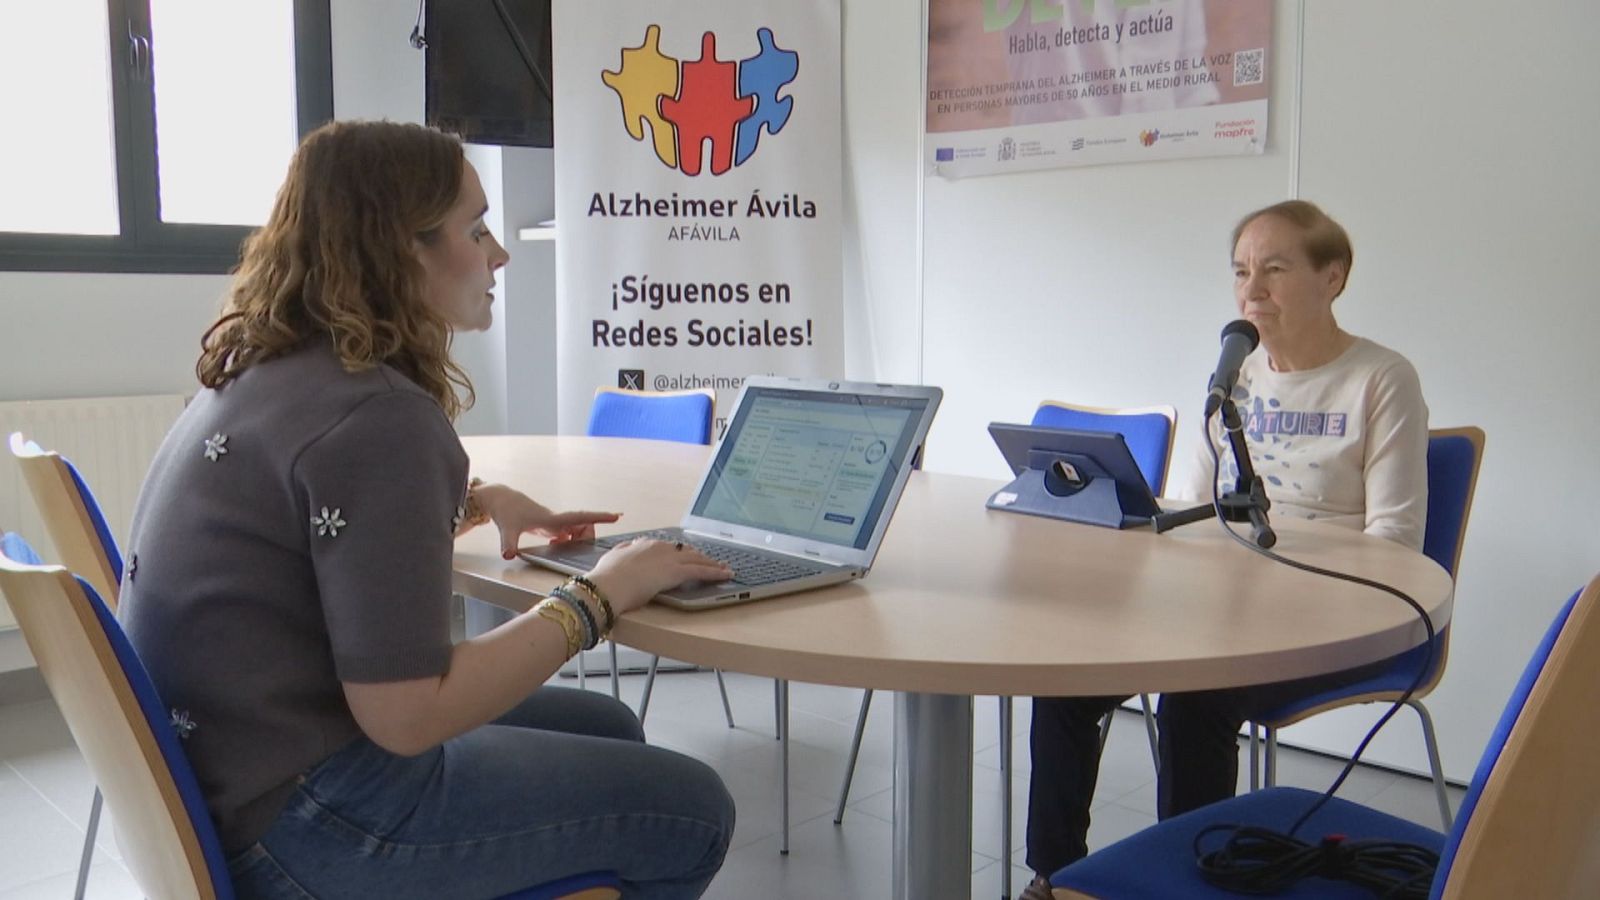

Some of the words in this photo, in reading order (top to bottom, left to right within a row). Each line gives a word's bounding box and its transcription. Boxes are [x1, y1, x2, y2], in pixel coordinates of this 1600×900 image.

[1009, 32, 1050, 55] Habla,
[1055, 23, 1110, 48] detecta
[1115, 22, 1124, 43] y
[1129, 9, 1173, 37] actúa
[929, 84, 983, 101] DETECCIÓN
[984, 79, 1035, 96] TEMPRANA
[1038, 76, 1057, 89] DEL
[1058, 67, 1116, 86] ALZHEIMER
[1119, 66, 1127, 79] A
[1129, 59, 1171, 77] TRAVÉS
[1174, 59, 1189, 72] DE
[1192, 56, 1206, 69] LA
[1210, 53, 1232, 67] VOZ
[937, 103, 951, 114] EN
[954, 98, 1002, 113] PERSONAS
[1004, 92, 1049, 107] MAYORES
[1051, 90, 1064, 101] DE
[1067, 88, 1079, 99] 50
[1081, 84, 1110, 98] AÑOS
[1112, 83, 1127, 95] EN
[1130, 80, 1143, 92] EL
[1146, 75, 1180, 91] MEDIO
[1184, 71, 1220, 86] RURAL
[1214, 128, 1255, 139] mapfre
[587, 192, 738, 218] Alzheimer
[746, 189, 817, 219] Ávila
[668, 223, 741, 242] AFÁVILA
[611, 275, 750, 311] ¡Síguenos
[758, 282, 791, 304] en
[592, 319, 678, 348] Redes
[687, 319, 813, 347] Sociales!
[653, 371, 775, 391] @alzheimer
